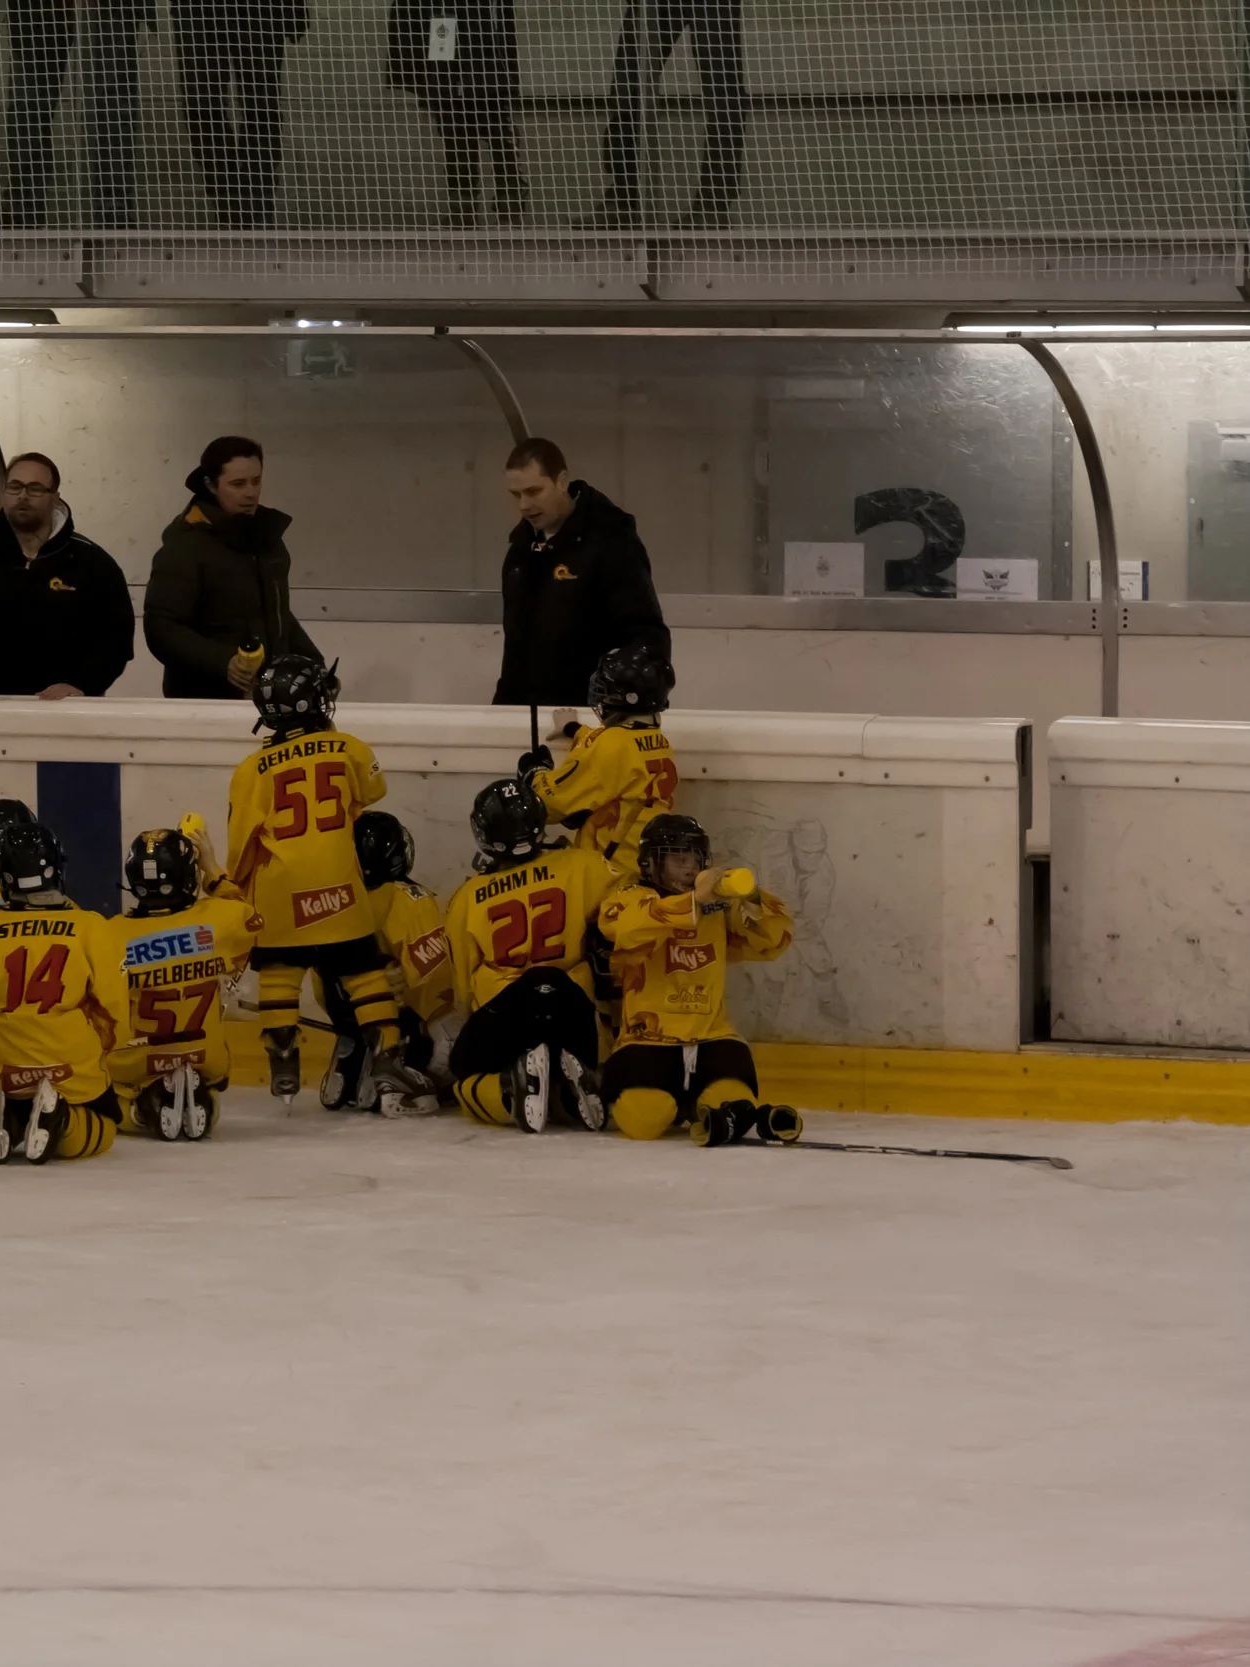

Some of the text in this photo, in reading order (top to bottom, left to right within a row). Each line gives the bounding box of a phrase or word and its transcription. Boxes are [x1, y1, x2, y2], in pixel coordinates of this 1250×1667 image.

[272, 761, 346, 841] 55
[501, 784, 519, 798] 22
[300, 888, 350, 918] Kelly's
[475, 866, 556, 904] BÖHM M.
[487, 887, 566, 968] 22
[0, 944, 70, 1015] 14
[136, 980, 218, 1045] 57
